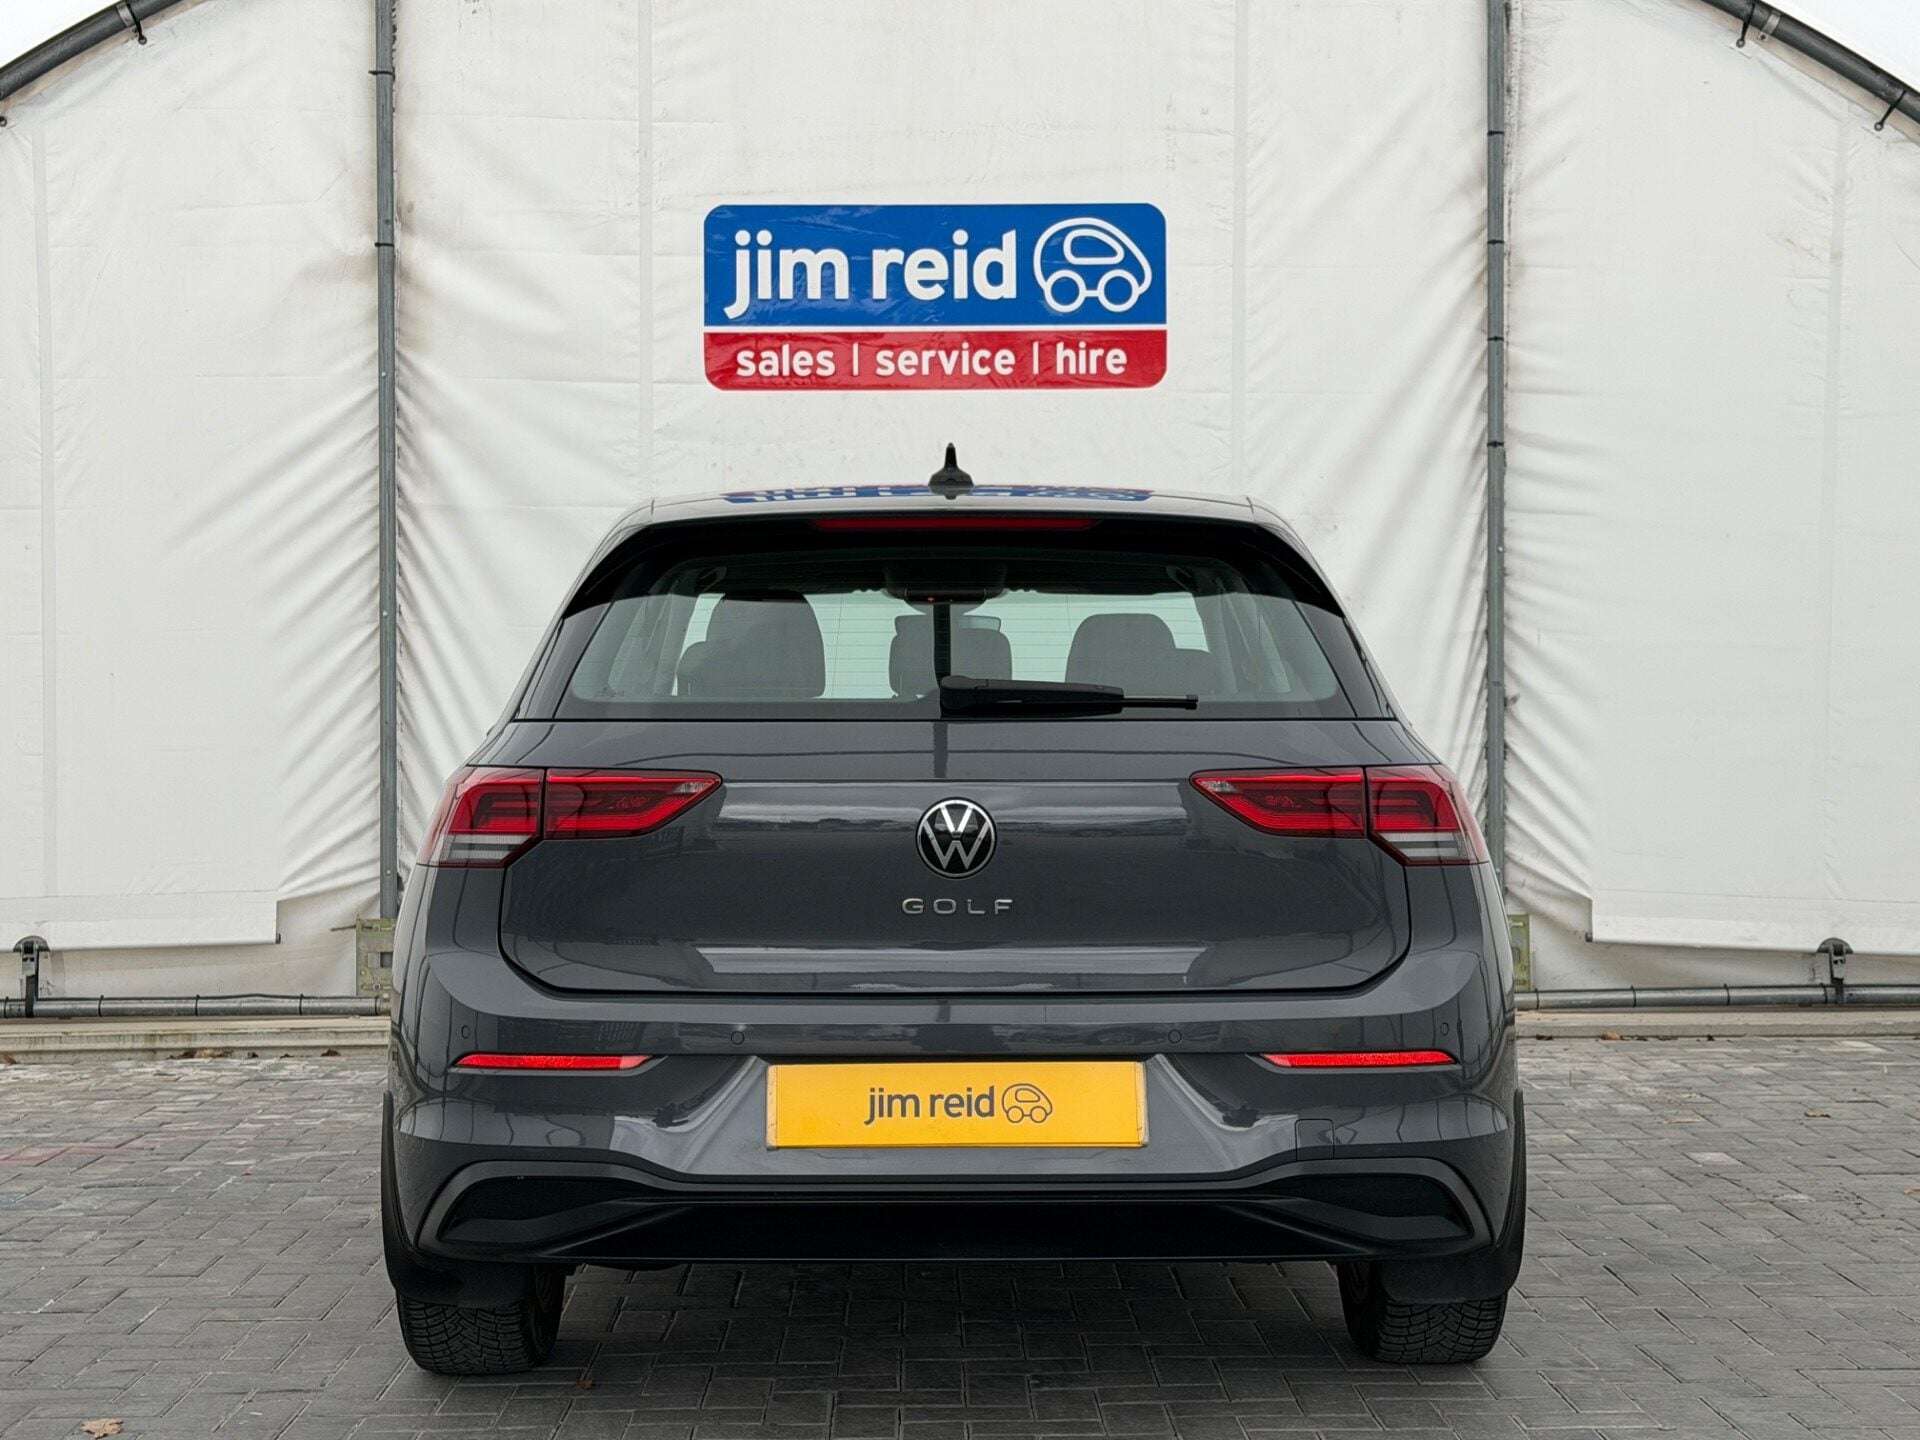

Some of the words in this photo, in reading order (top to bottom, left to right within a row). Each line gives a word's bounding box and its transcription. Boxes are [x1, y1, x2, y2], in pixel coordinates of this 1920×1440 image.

[723, 229, 849, 320] jim
[870, 228, 1018, 301] reid
[736, 344, 836, 377] sales
[874, 343, 1017, 376] service
[1055, 341, 1129, 375] hire
[902, 897, 1014, 915] GOLF
[864, 1087, 921, 1125] jim
[929, 1085, 996, 1118] reid
